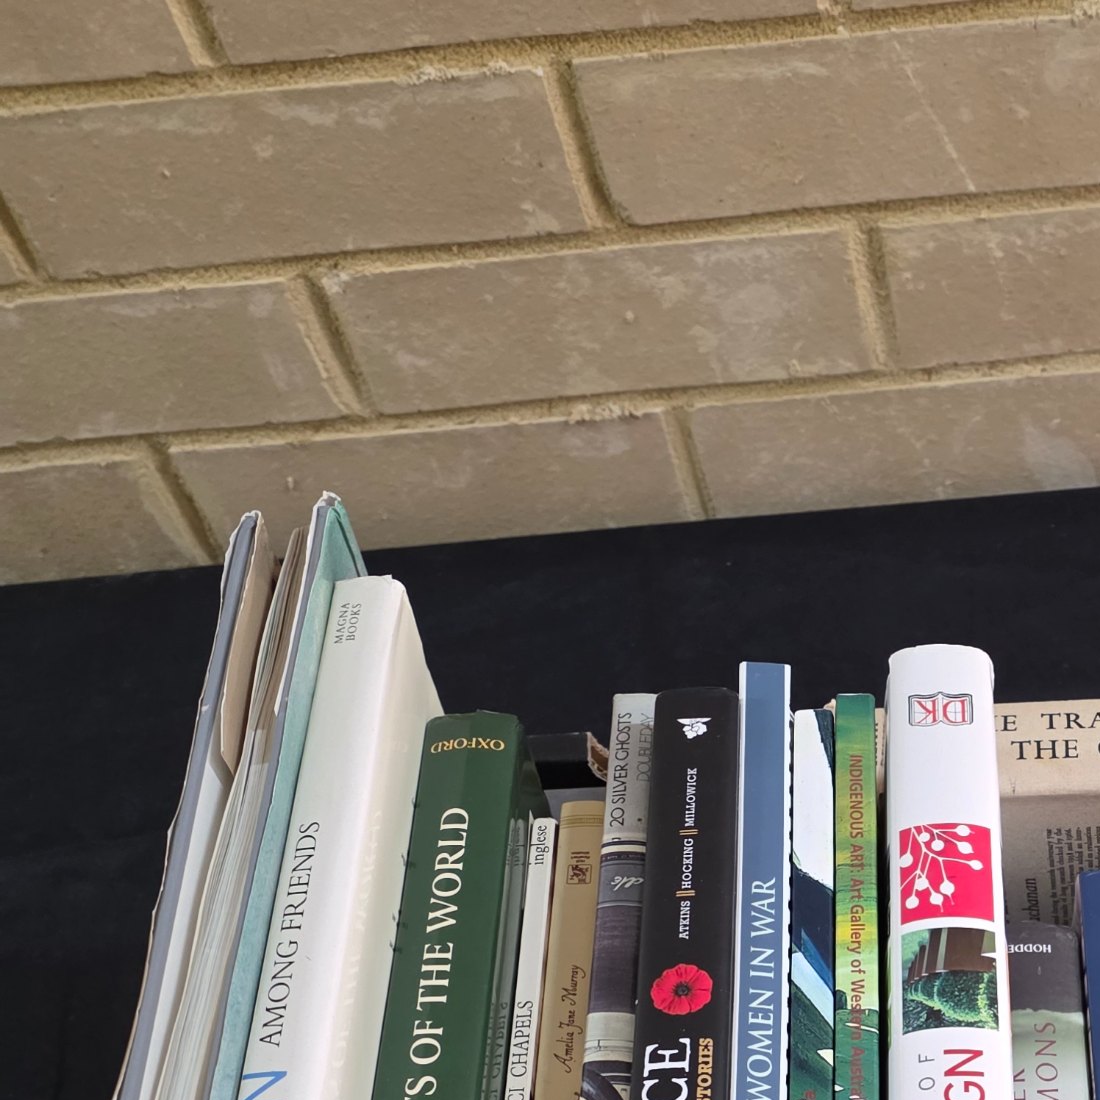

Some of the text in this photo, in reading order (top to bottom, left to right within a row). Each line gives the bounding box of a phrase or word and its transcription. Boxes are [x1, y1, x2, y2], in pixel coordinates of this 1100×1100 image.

[333, 601, 351, 644] MAGNA
[345, 602, 362, 642] BOOKS
[915, 698, 968, 724] DK
[431, 737, 505, 754] OXFORD
[610, 713, 632, 828] 20 SILVER GHOSTS
[636, 713, 653, 782] DOUBLEDAY
[1010, 735, 1080, 761] THE
[848, 754, 864, 839] INDIGENOUS
[426, 807, 470, 933] WORLD
[679, 767, 698, 940] ATKINS HOCKING MILLOWICK
[751, 876, 776, 938] WAR
[849, 878, 866, 901] Art
[259, 820, 320, 1048] AMONG FRIENDS
[510, 1000, 534, 1077] CHAPELS
[529, 825, 549, 866] inglese
[846, 904, 866, 954] Gallery
[416, 942, 454, 1011] THE
[750, 946, 775, 978] IN
[850, 958, 866, 975] of
[553, 965, 587, 1074] Amelia Jane Murray
[850, 979, 867, 1040] Western
[410, 1020, 443, 1065] OF
[918, 1053, 936, 1091] OF
